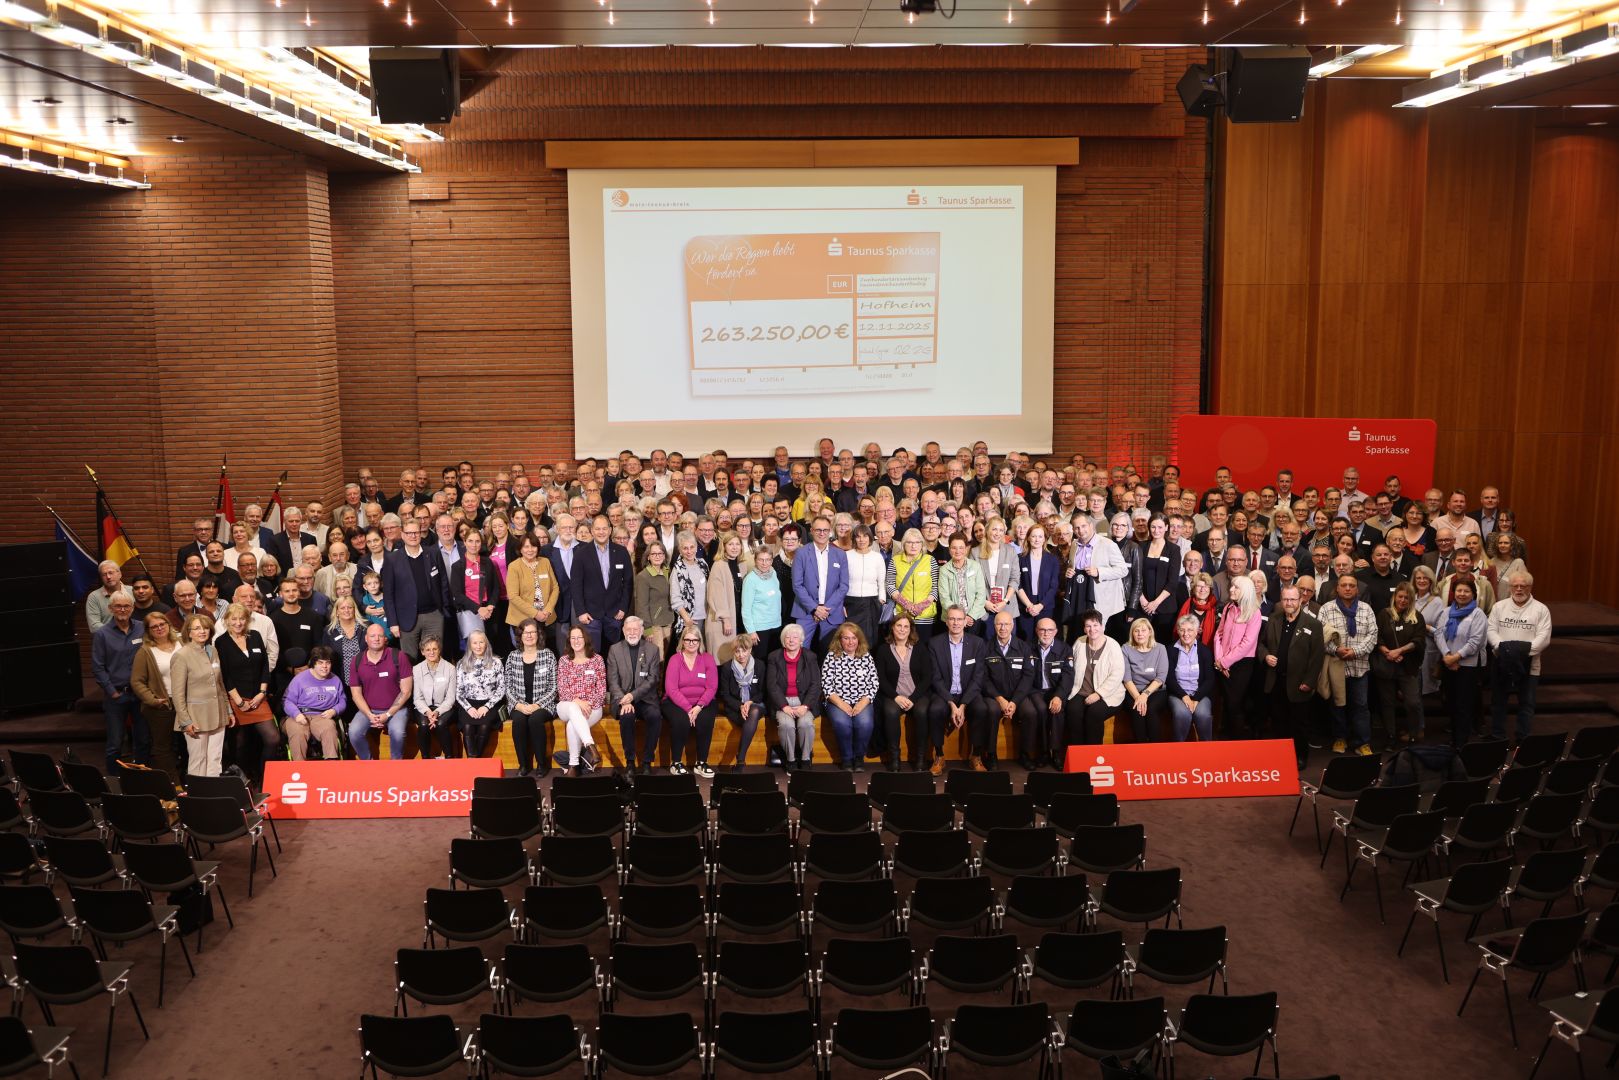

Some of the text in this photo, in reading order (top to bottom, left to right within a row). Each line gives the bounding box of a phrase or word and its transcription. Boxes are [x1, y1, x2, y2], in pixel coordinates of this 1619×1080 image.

[938, 196, 968, 205] Taunus
[970, 196, 1012, 207] Sparkasse
[847, 246, 884, 256] Taunus
[886, 244, 936, 257] Sparkasse
[860, 300, 932, 311] Hofheim
[1365, 433, 1397, 442] Taunus
[1365, 445, 1410, 455] Sparkasse
[1123, 770, 1188, 786] Taunus
[1191, 767, 1281, 787] Sparkasse
[316, 787, 382, 804] Taunus
[387, 785, 473, 806] Sparkass
